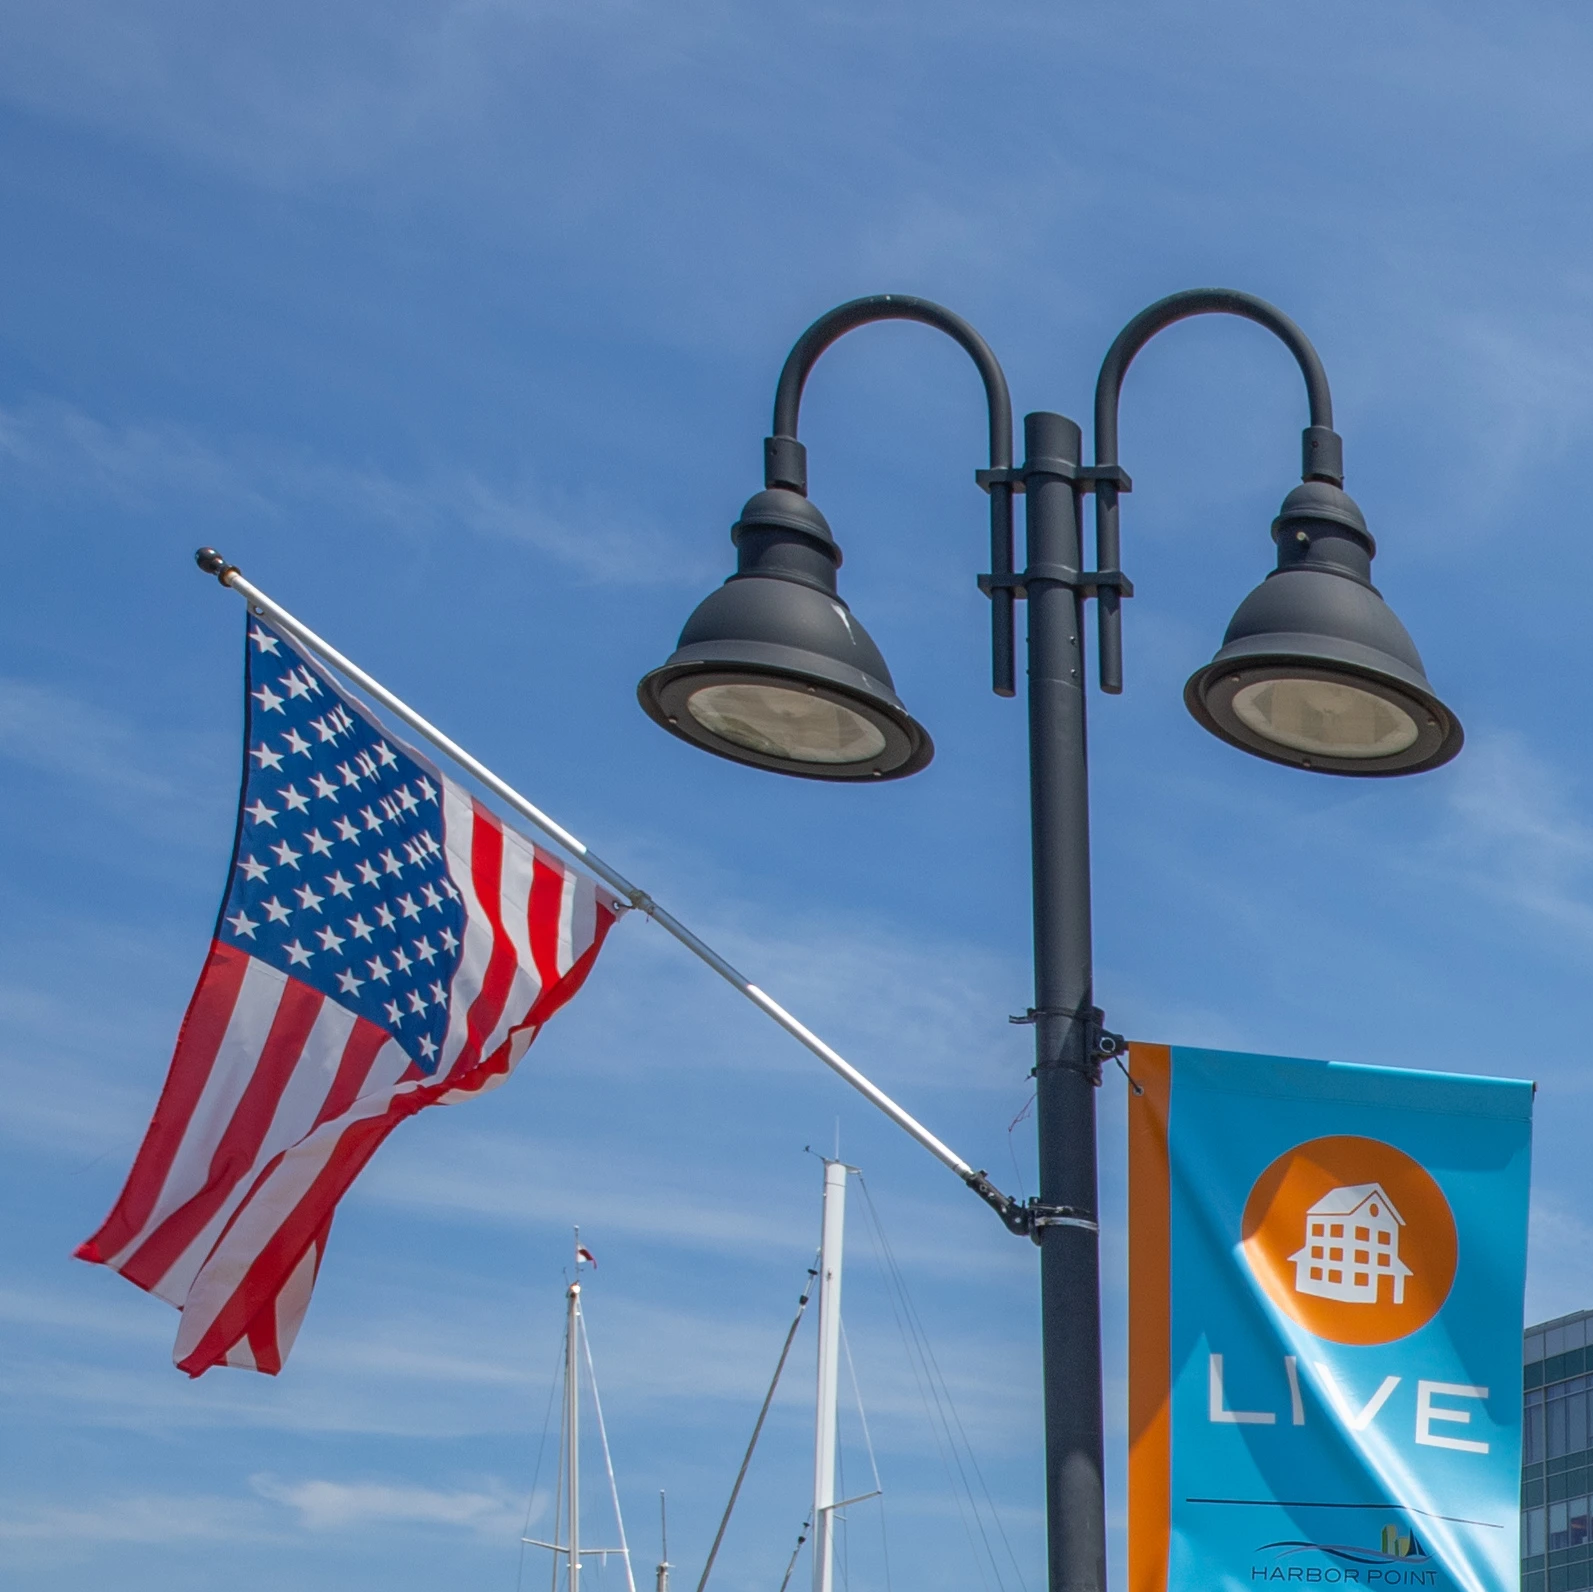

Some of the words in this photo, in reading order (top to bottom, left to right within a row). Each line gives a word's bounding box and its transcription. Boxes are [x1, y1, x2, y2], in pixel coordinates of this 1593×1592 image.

[1208, 1352, 1491, 1455] LIVE
[1251, 1565, 1360, 1584] HARBOR
[1367, 1568, 1439, 1586] POINT
